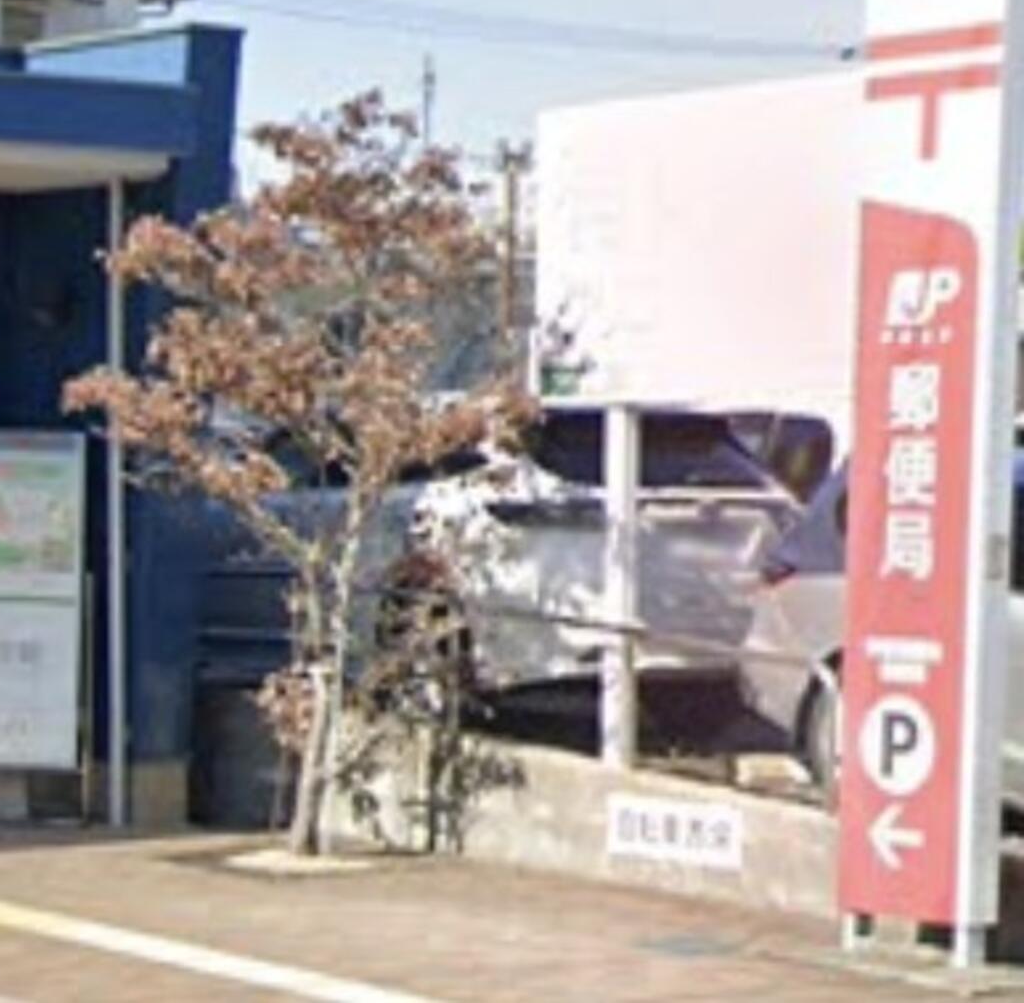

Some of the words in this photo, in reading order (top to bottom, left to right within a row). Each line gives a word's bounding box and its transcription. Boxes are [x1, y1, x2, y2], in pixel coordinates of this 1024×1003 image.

[879, 363, 942, 581] 郵便局
[880, 710, 918, 778] P
